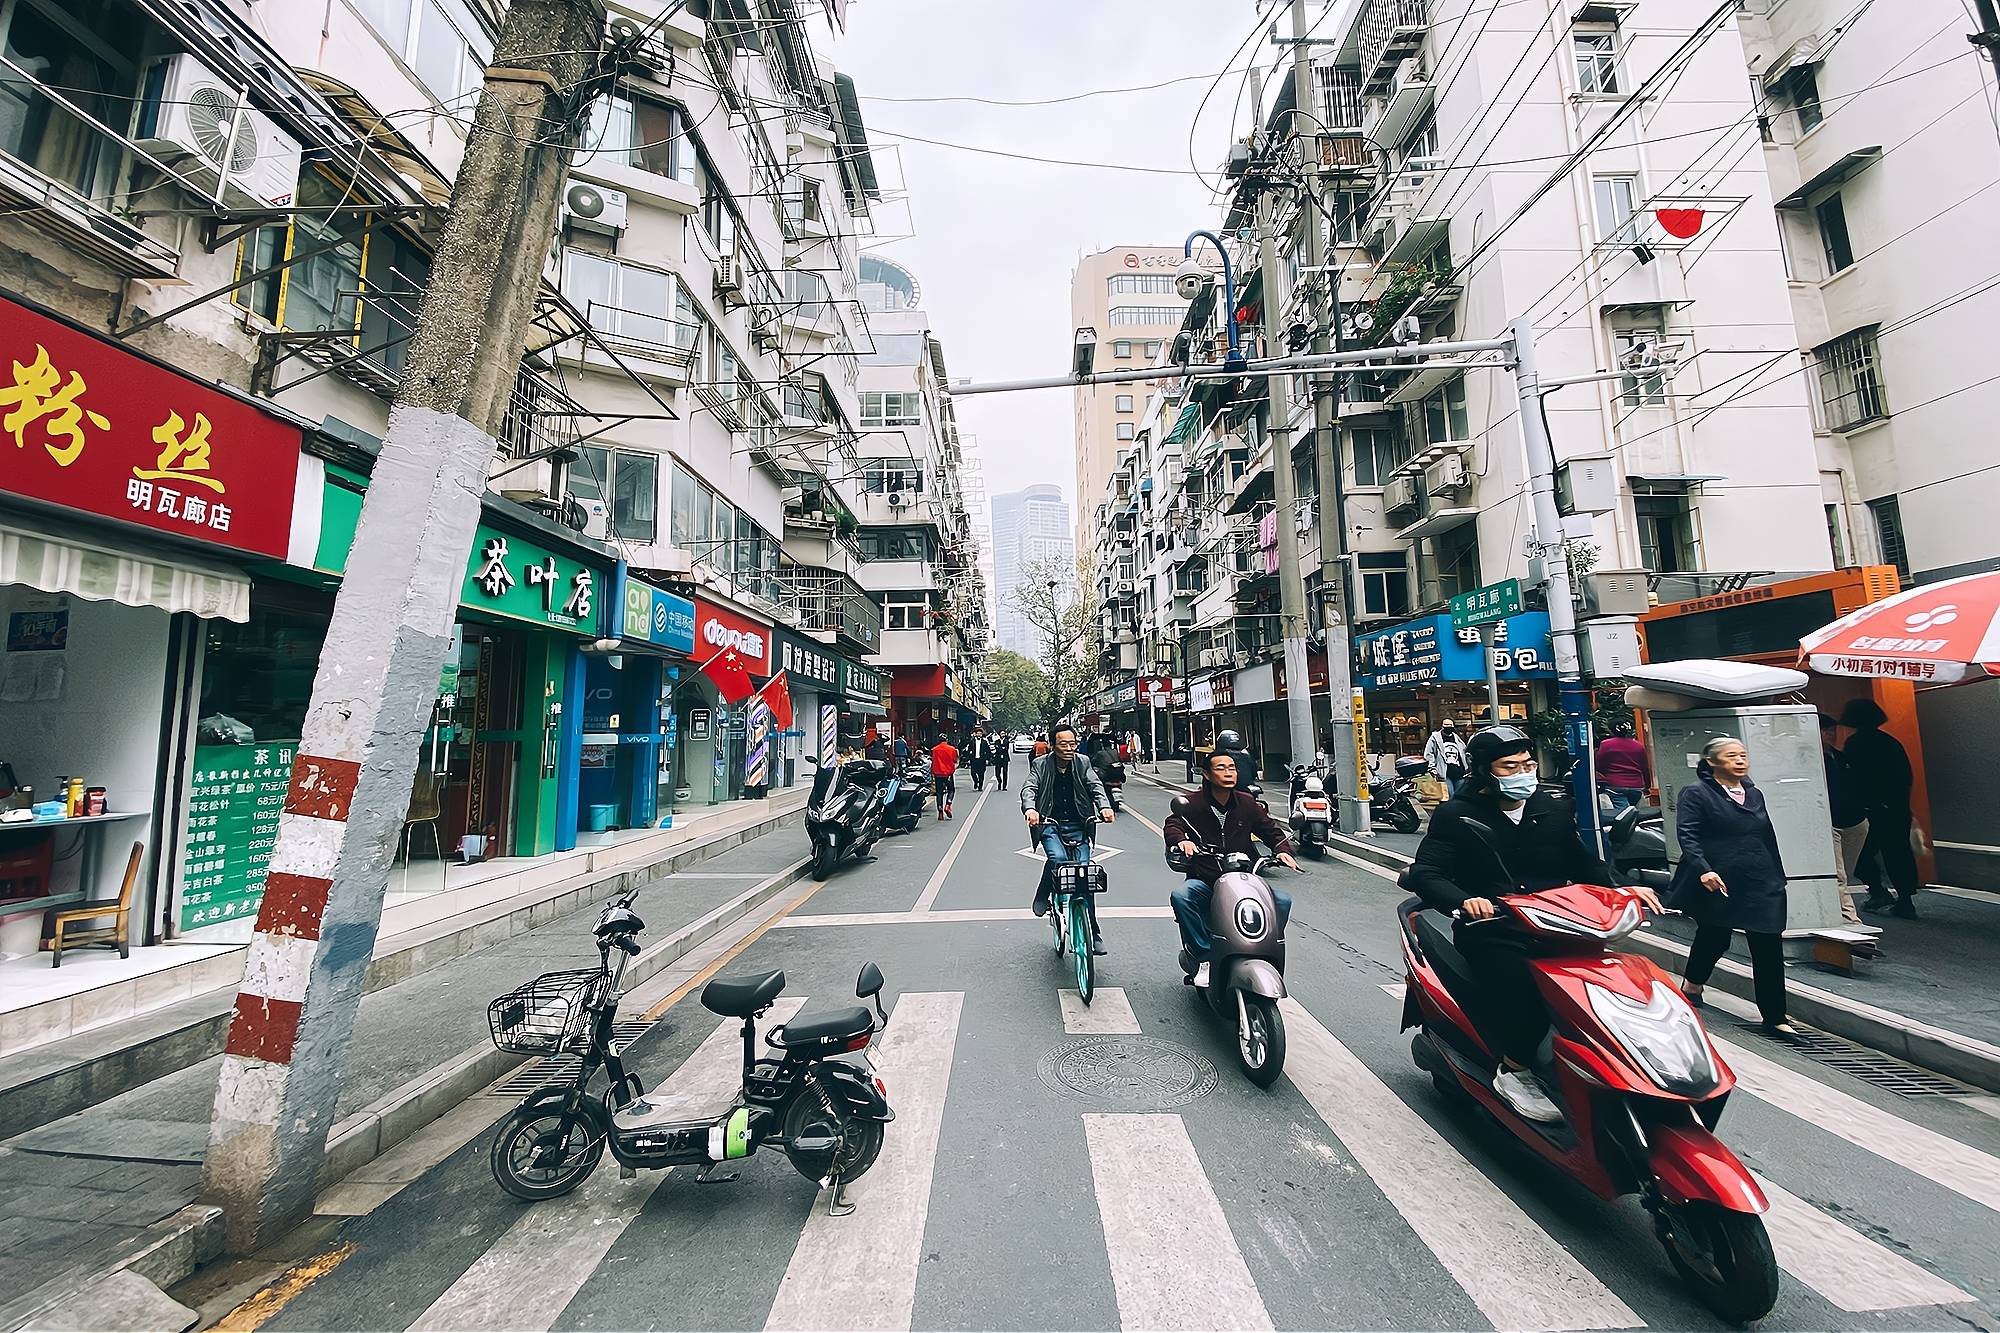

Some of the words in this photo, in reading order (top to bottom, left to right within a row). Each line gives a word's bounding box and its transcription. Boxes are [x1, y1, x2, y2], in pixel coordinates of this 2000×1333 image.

[0, 343, 226, 494] 粉丝
[125, 477, 233, 532] 明瓦廊店
[473, 537, 593, 618] 茶叶店
[1466, 588, 1500, 611] 明瓦廊
[1493, 647, 1538, 671] 面包
[1831, 657, 1936, 679] 小初高1对1辅导
[441, 694, 455, 708] 推
[551, 702, 562, 714] 推
